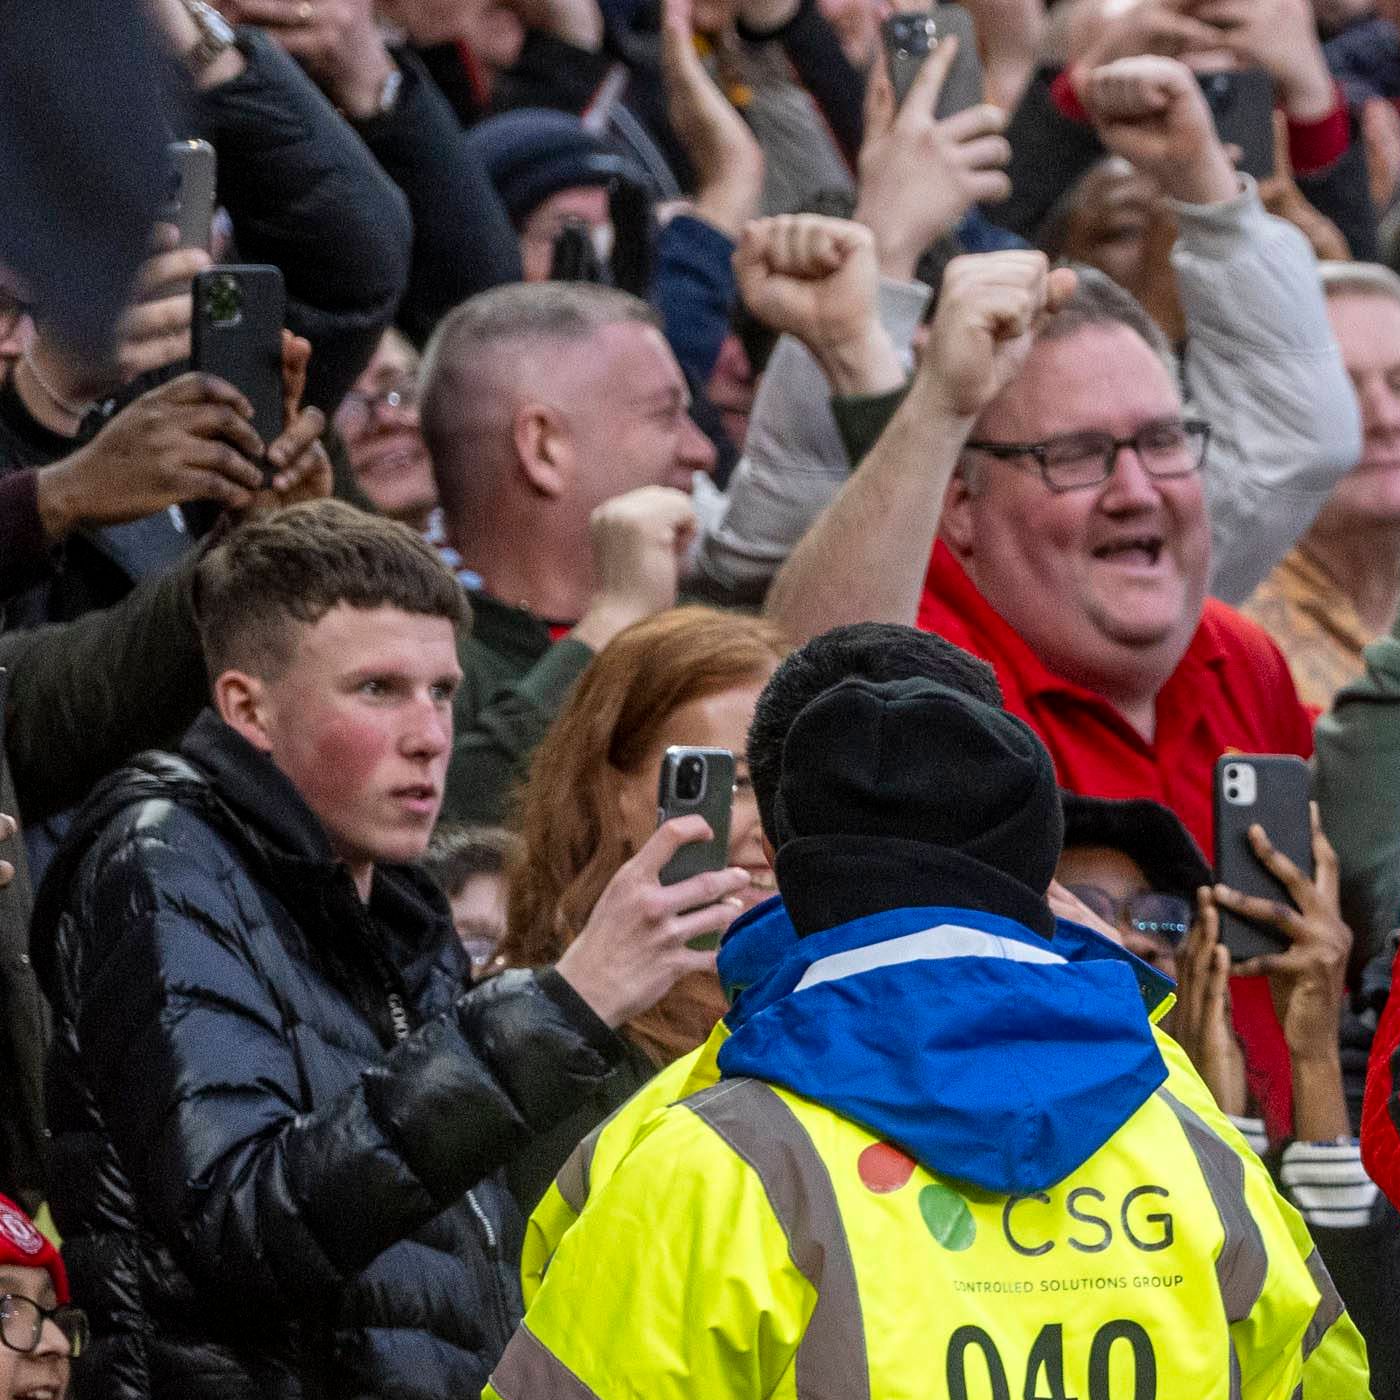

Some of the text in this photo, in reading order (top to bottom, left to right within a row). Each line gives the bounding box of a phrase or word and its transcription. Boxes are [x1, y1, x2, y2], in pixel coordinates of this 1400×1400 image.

[1002, 1184, 1174, 1257] CSG
[1039, 1276, 1128, 1292] SOLUTIONS
[1132, 1274, 1184, 1288] GROUP
